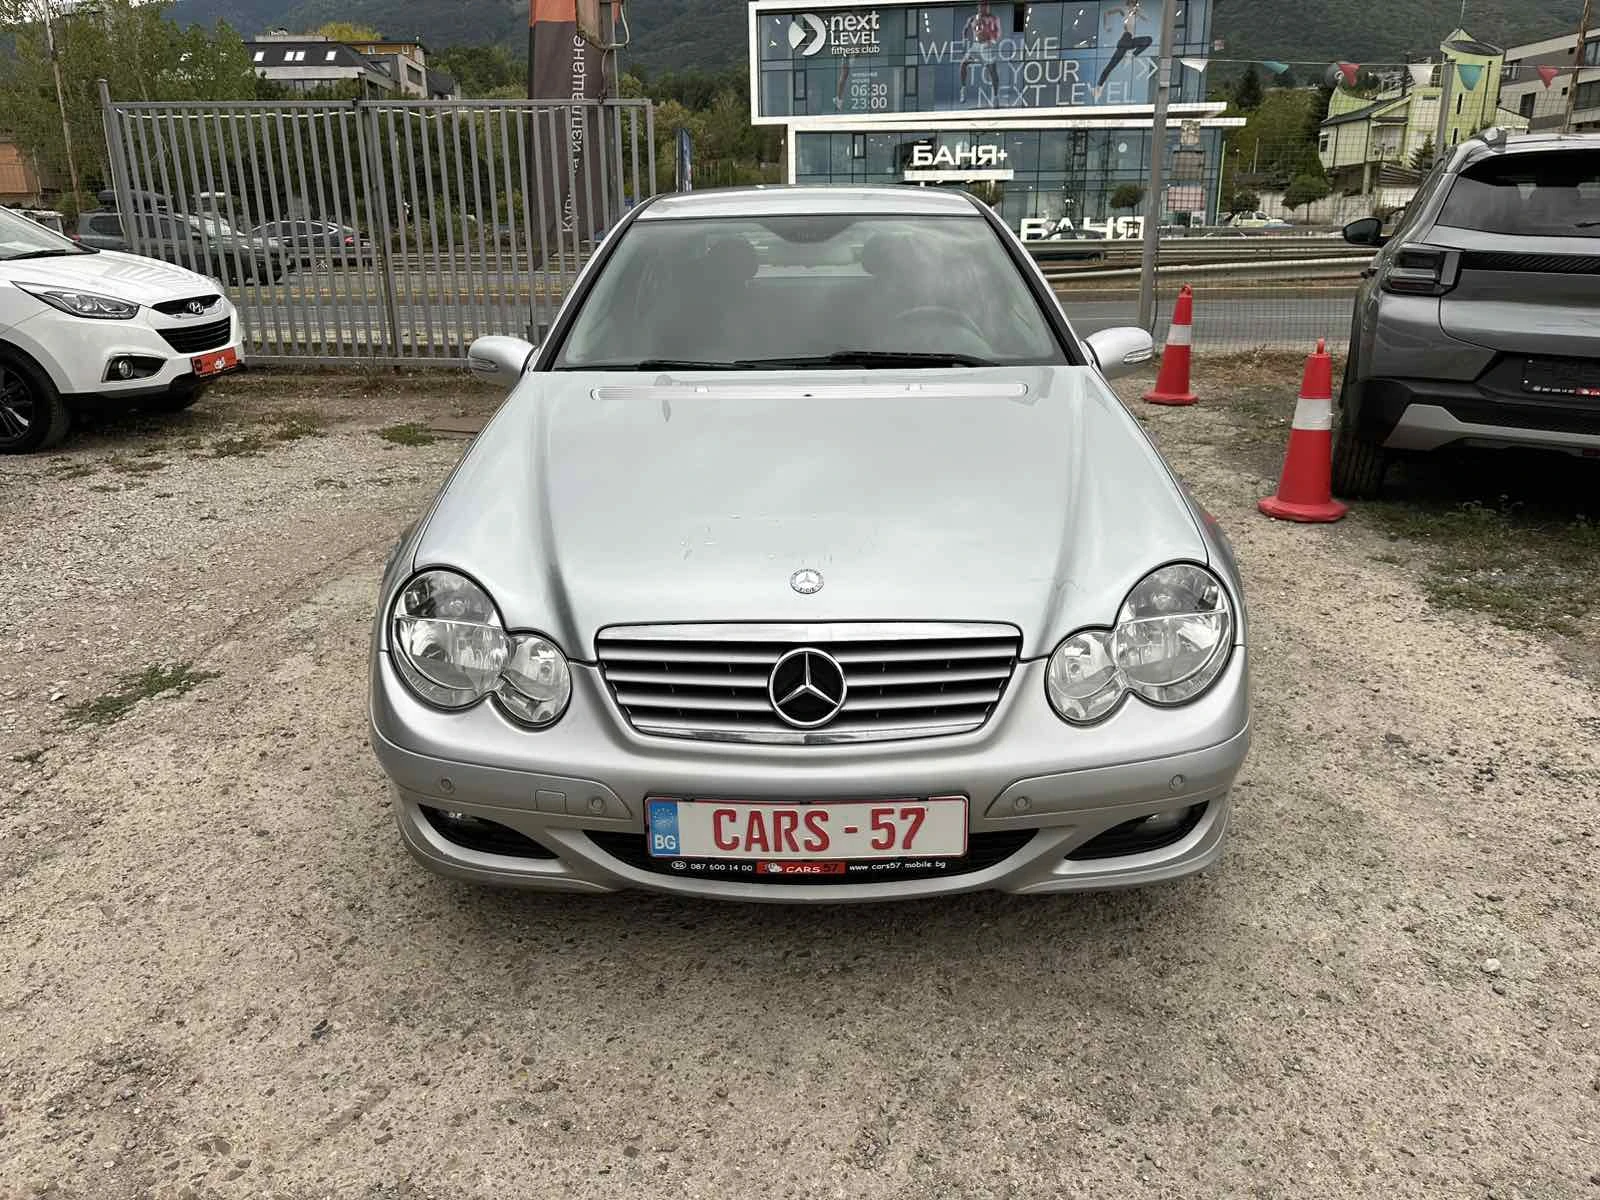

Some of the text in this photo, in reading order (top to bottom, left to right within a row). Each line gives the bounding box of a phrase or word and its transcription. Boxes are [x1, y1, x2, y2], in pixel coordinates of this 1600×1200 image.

[831, 10, 880, 30] next
[831, 31, 880, 45] LEVEL
[832, 46, 880, 55] fitness club
[1008, 60, 1080, 84] YOUR
[850, 84, 888, 97] 06:30
[978, 84, 1047, 108] NEXT
[850, 97, 888, 110] 23:00
[1020, 216, 1145, 241] БАНЯ
[655, 834, 677, 850] BG
[713, 808, 830, 852] CARS
[871, 807, 927, 850] 57
